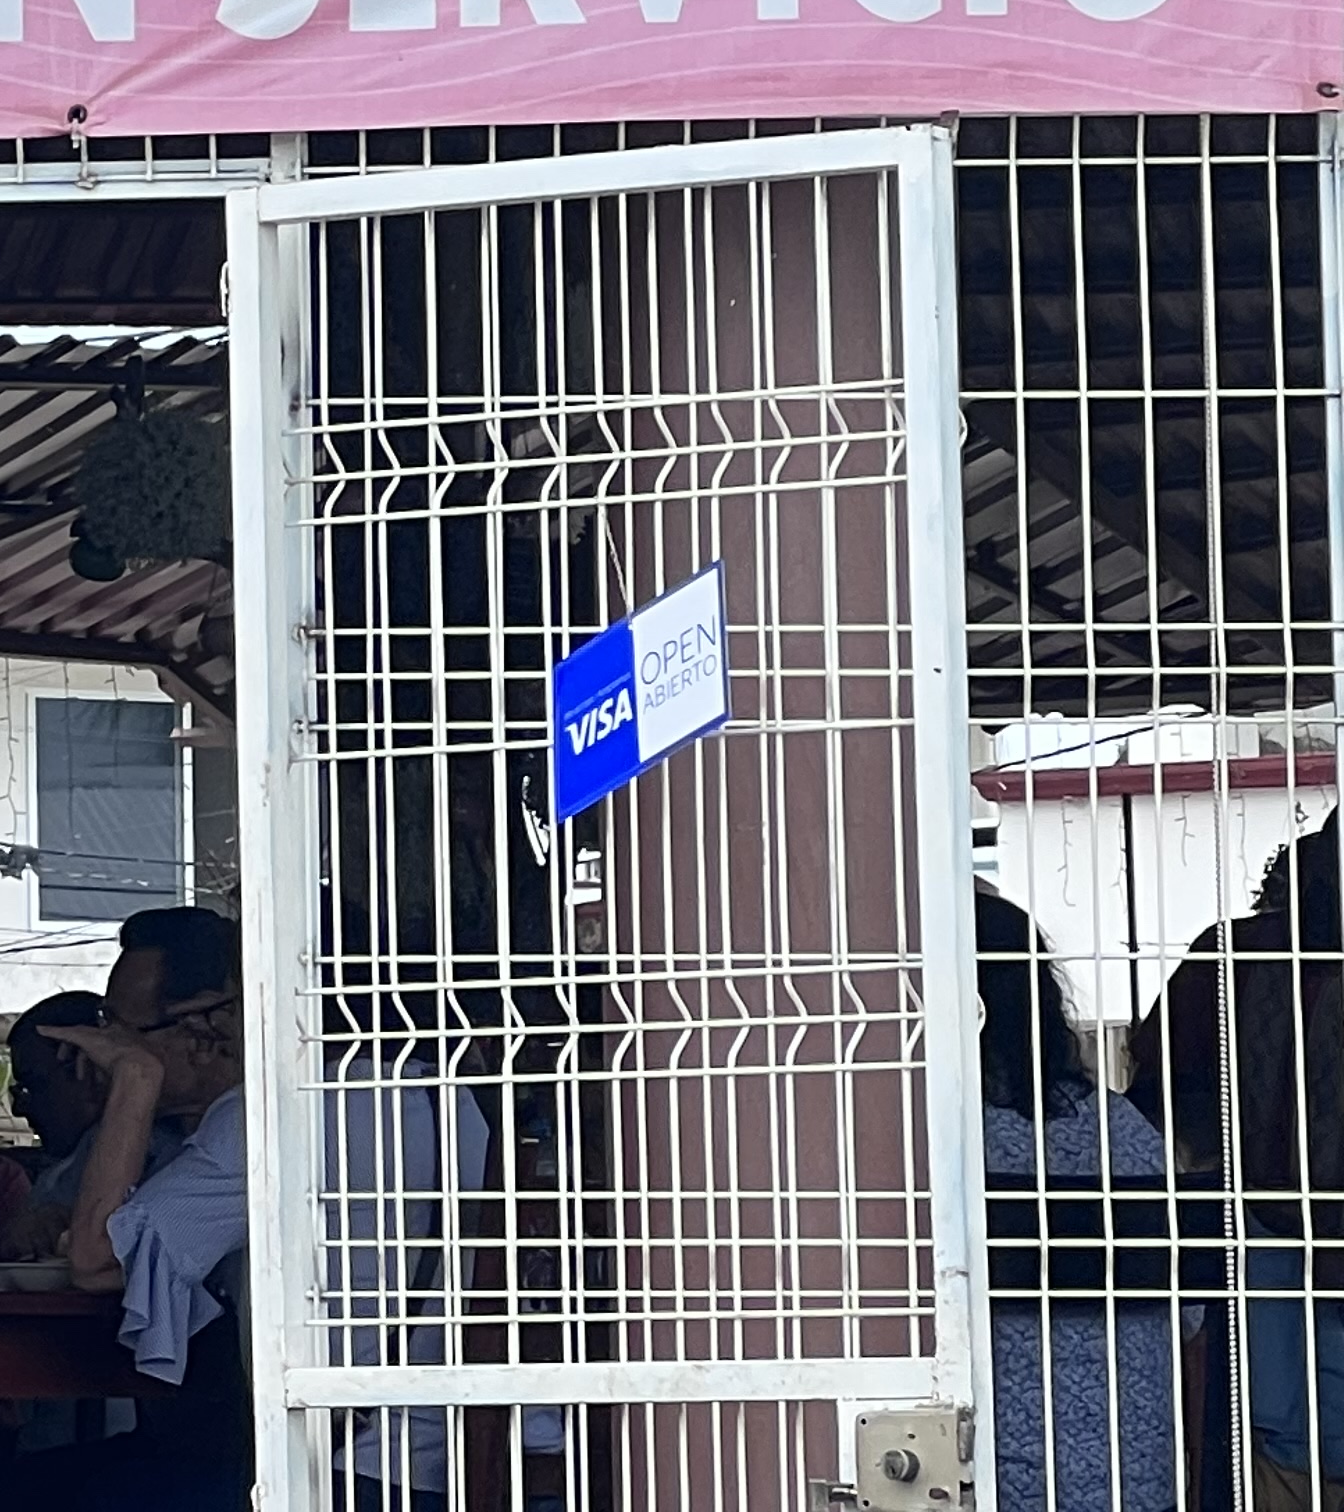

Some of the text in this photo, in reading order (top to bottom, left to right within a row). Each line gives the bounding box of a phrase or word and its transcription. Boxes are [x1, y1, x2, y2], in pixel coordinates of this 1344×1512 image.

[641, 614, 716, 685] OPEN
[642, 654, 717, 715] ABIERTO
[564, 688, 633, 756] VISA
